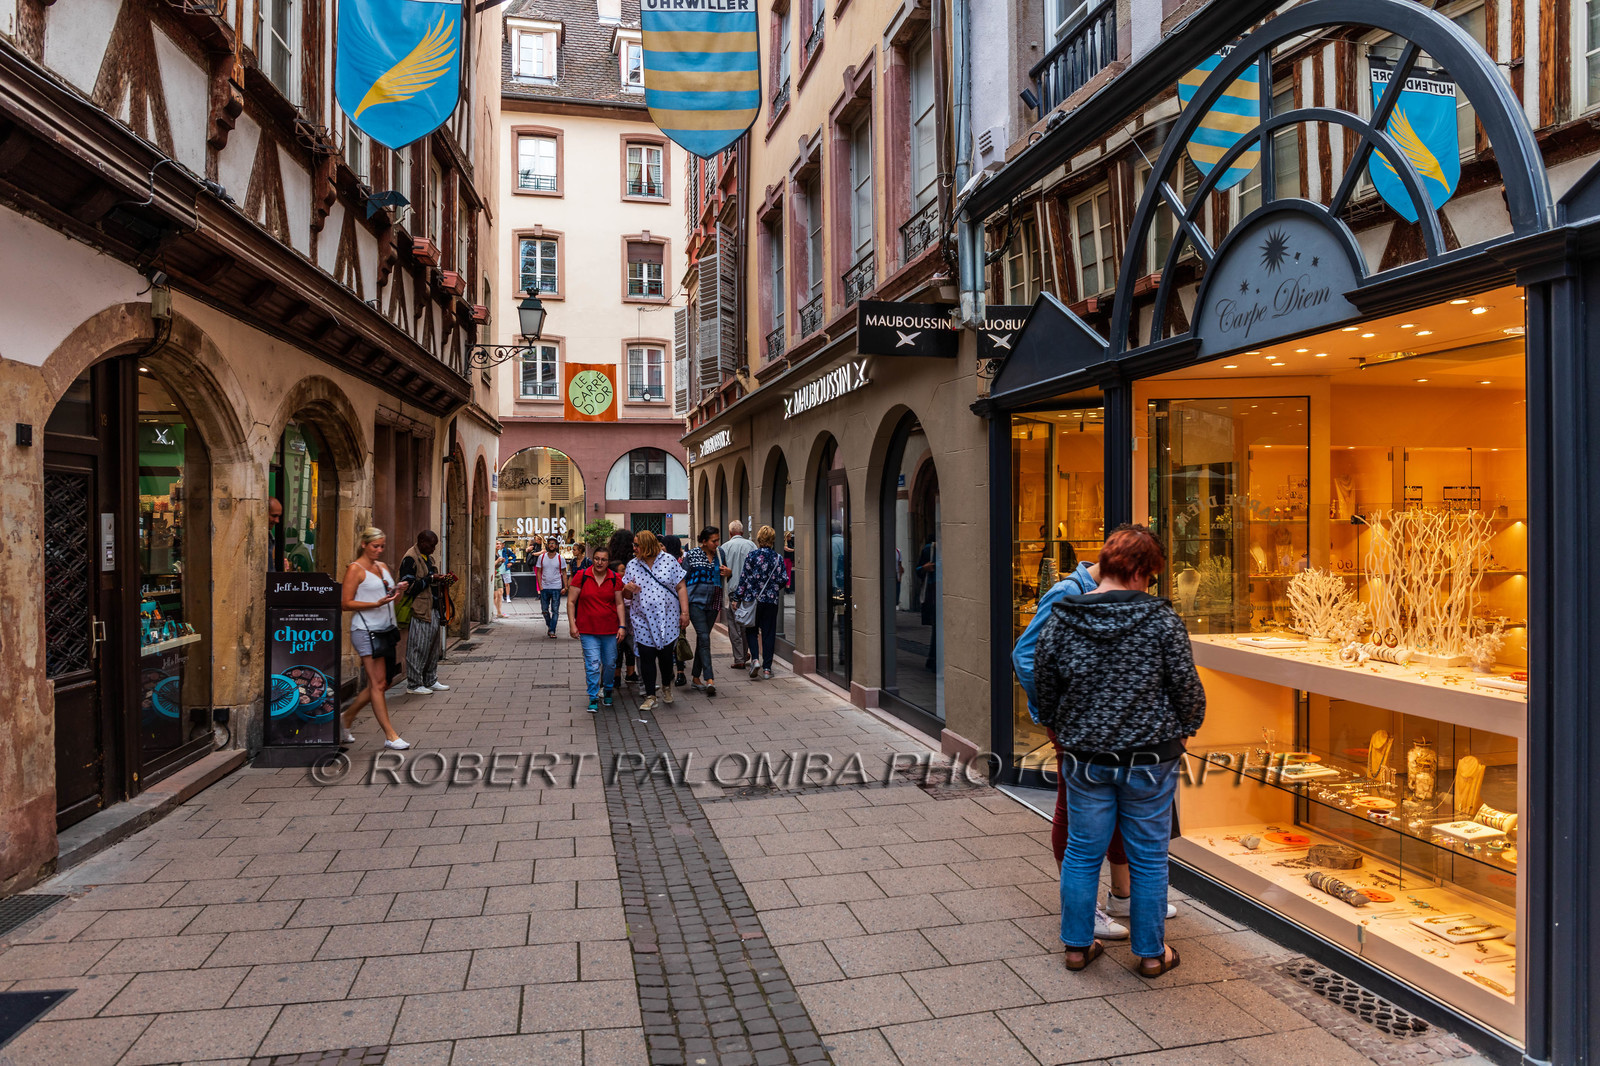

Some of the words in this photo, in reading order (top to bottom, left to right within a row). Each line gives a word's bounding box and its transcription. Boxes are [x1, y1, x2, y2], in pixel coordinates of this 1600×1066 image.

[647, 0, 749, 10] UHRWILLER
[1215, 299, 1268, 338] Carpe
[1271, 273, 1331, 319] Diem
[865, 314, 951, 330] MAUBOUSSIN
[572, 371, 607, 408] CARRÉ
[574, 375, 588, 389] LE
[793, 363, 851, 415] MAUBOUSSIN
[583, 385, 612, 415] D'OR
[516, 517, 567, 535] SOLDES
[274, 582, 292, 593] Jeff
[301, 581, 333, 595] Bruges
[274, 625, 334, 642] choco
[289, 641, 316, 655] jeff
